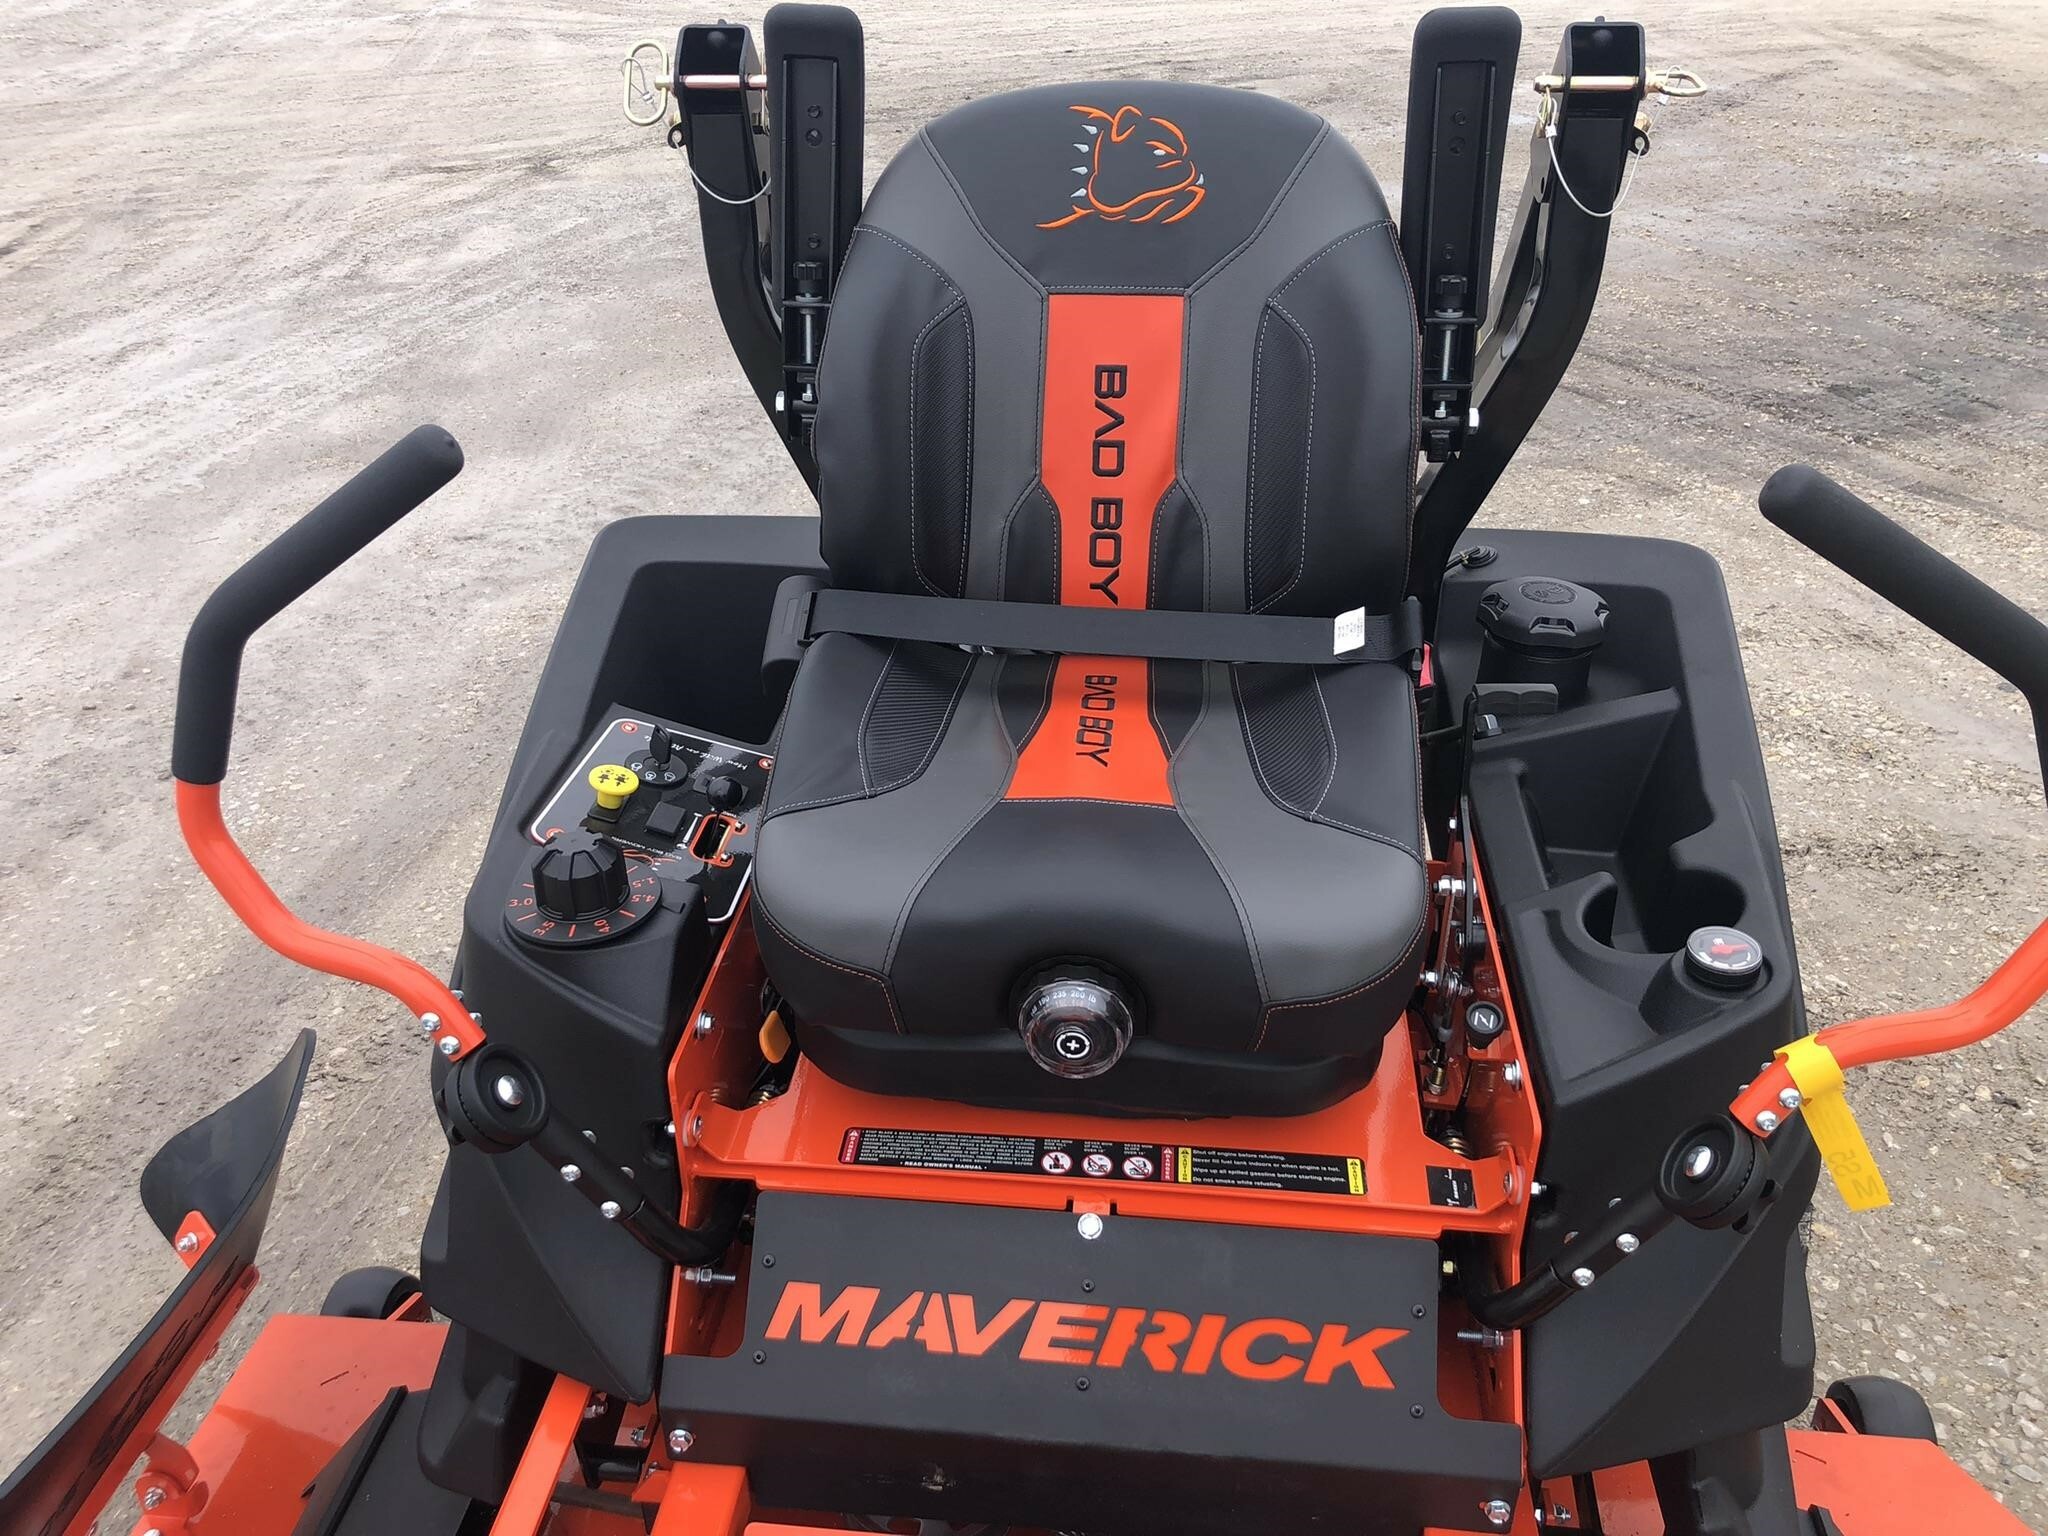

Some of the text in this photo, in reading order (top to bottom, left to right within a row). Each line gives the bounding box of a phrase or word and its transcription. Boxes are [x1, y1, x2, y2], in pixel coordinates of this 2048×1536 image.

[1089, 365, 1127, 606] BAD BOY
[1075, 674, 1118, 768] BAD BOY
[765, 1281, 1412, 1389] MAVERICK
